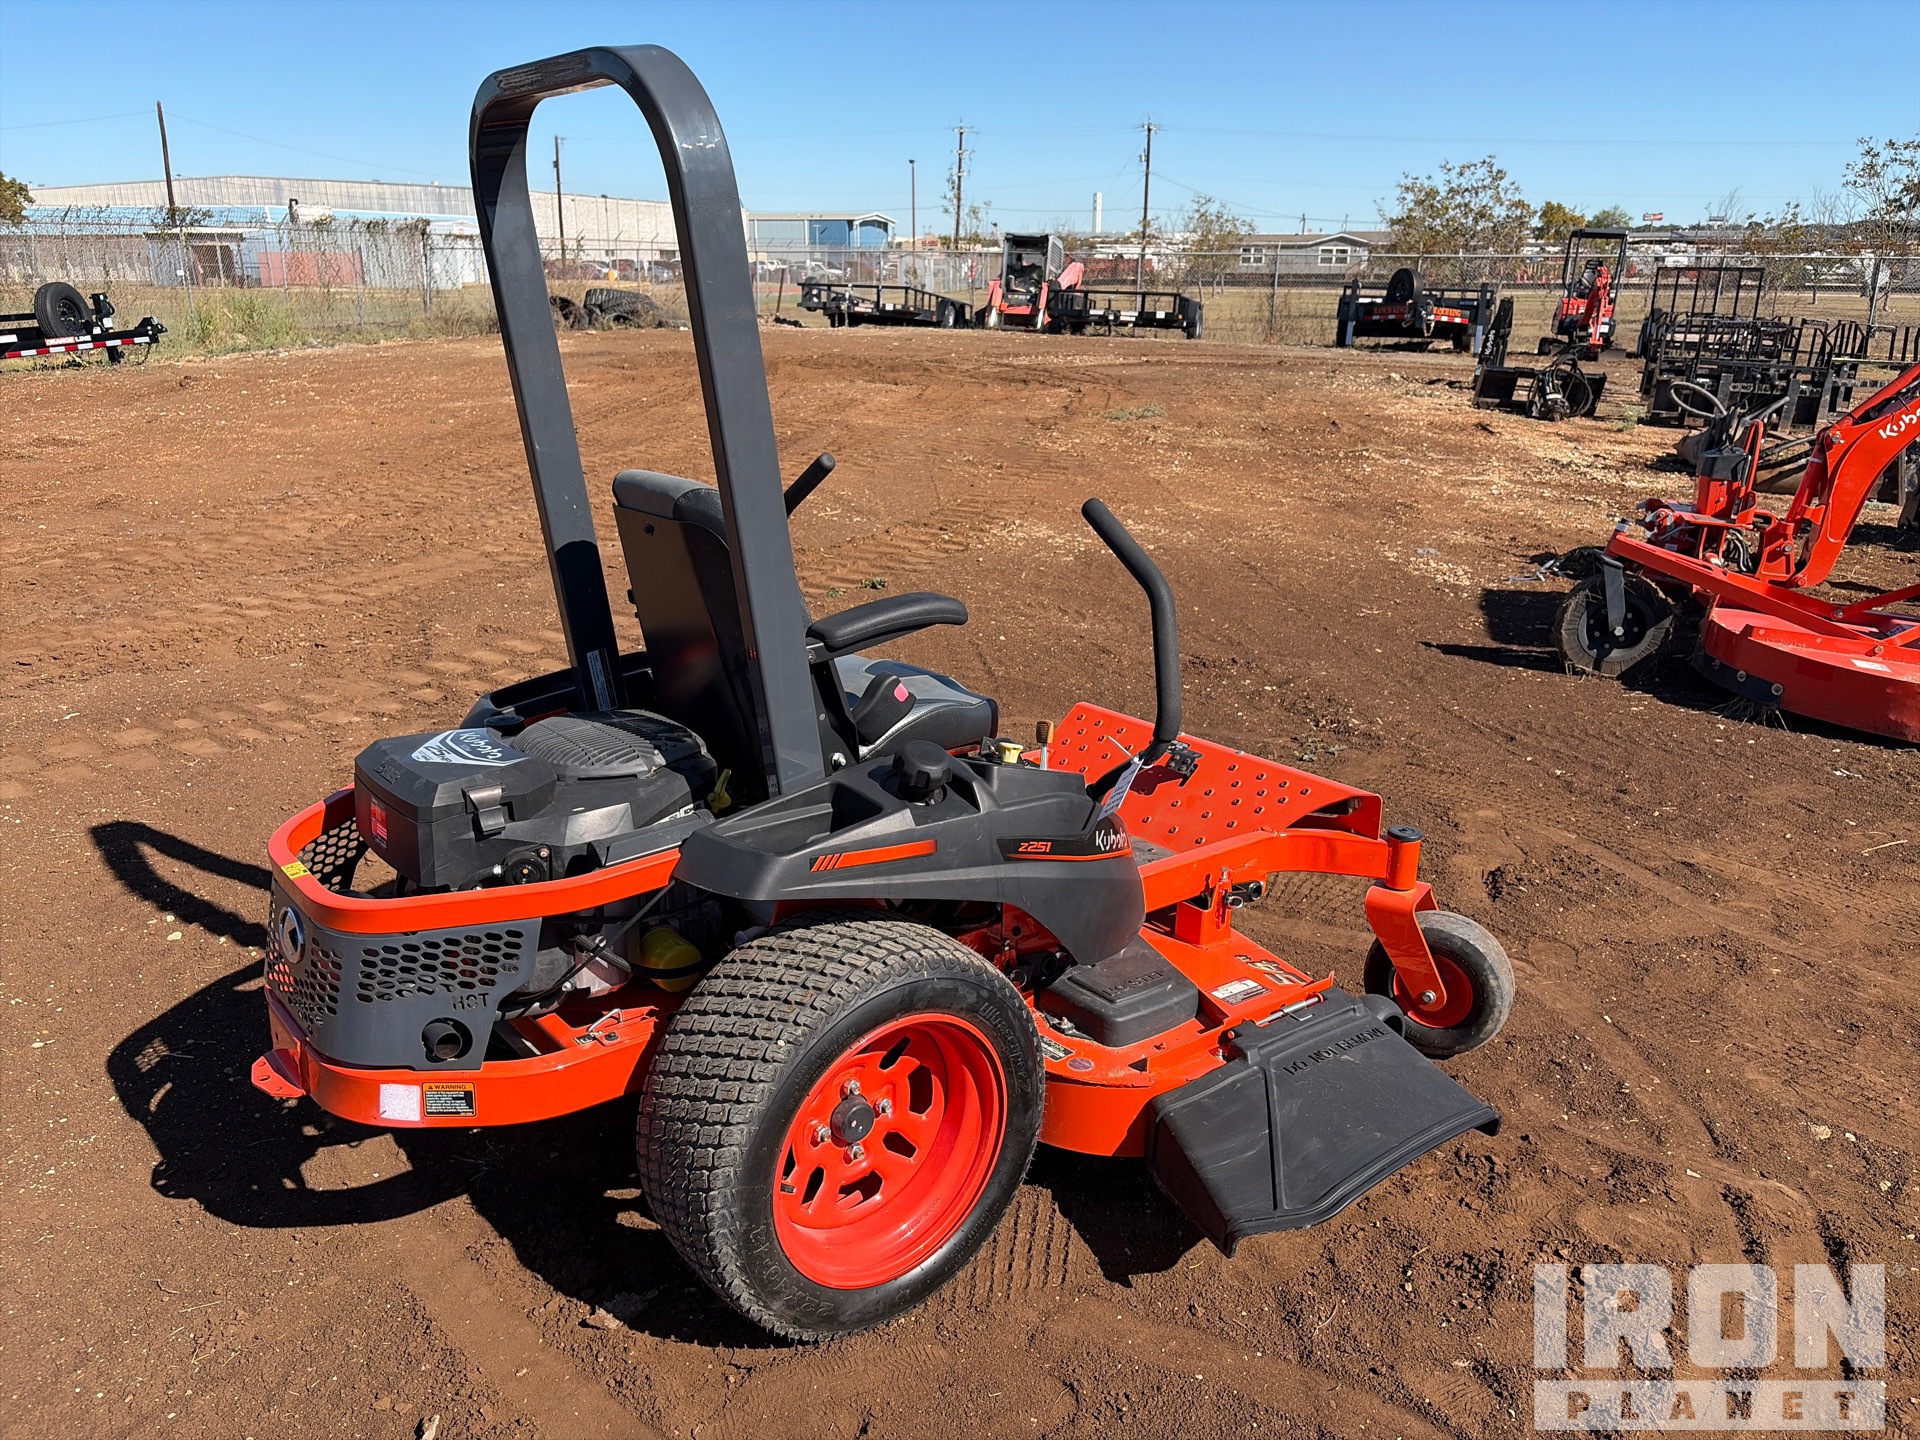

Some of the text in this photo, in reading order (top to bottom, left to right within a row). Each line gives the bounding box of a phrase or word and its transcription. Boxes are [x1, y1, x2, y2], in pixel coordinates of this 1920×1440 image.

[45, 334, 92, 346] ORANGE LINE
[460, 732, 503, 760] Kubota
[1095, 827, 1128, 852] Kubota
[1283, 1060, 1310, 1075] DO
